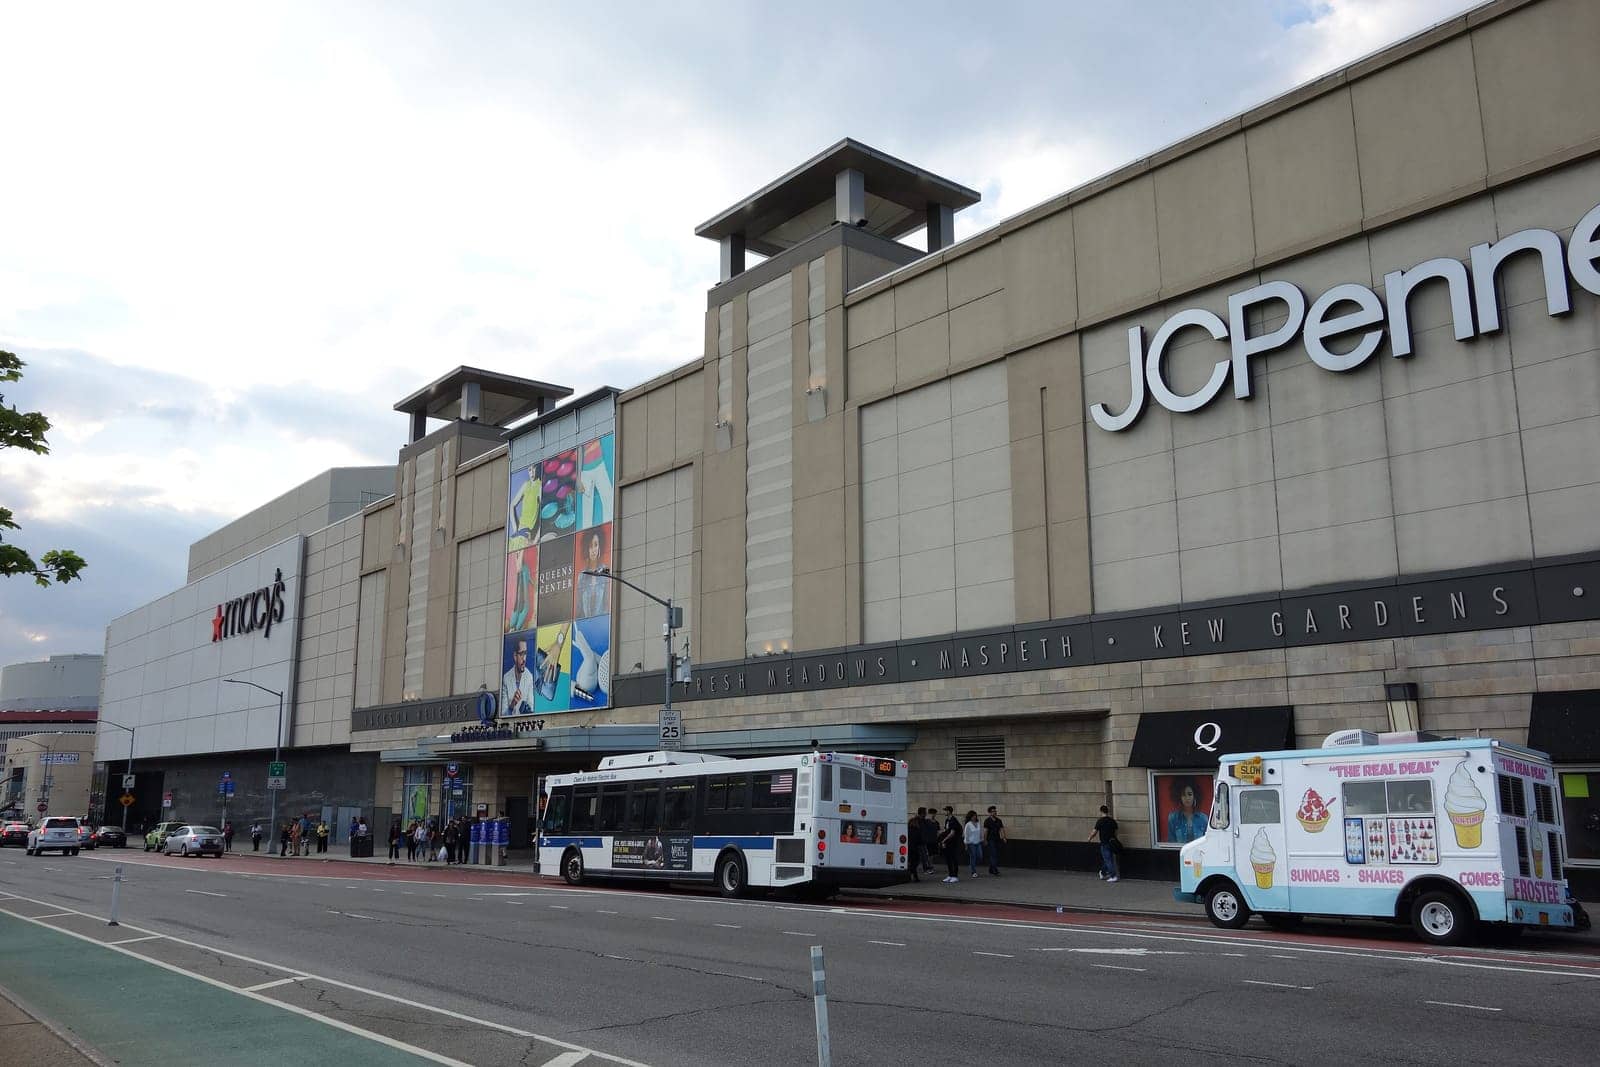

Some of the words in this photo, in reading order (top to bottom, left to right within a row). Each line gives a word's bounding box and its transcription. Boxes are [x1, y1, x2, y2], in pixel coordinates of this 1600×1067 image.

[540, 565, 572, 584] QUEENS
[540, 579, 572, 594] CENTER
[1153, 618, 1224, 649] KEW
[1271, 586, 1509, 637] GARDENS
[939, 635, 1073, 670] MASPETH
[768, 657, 887, 687] MEADOWS
[662, 726, 679, 738] 25
[1193, 722, 1222, 752] Q
[1240, 765, 1261, 774] SLOW
[1362, 763, 1397, 777] REAL
[1290, 869, 1340, 882] SUNDAES
[1358, 869, 1405, 883] SHAKES
[1460, 872, 1500, 886] CONES
[1513, 879, 1560, 904] FROSTEE
